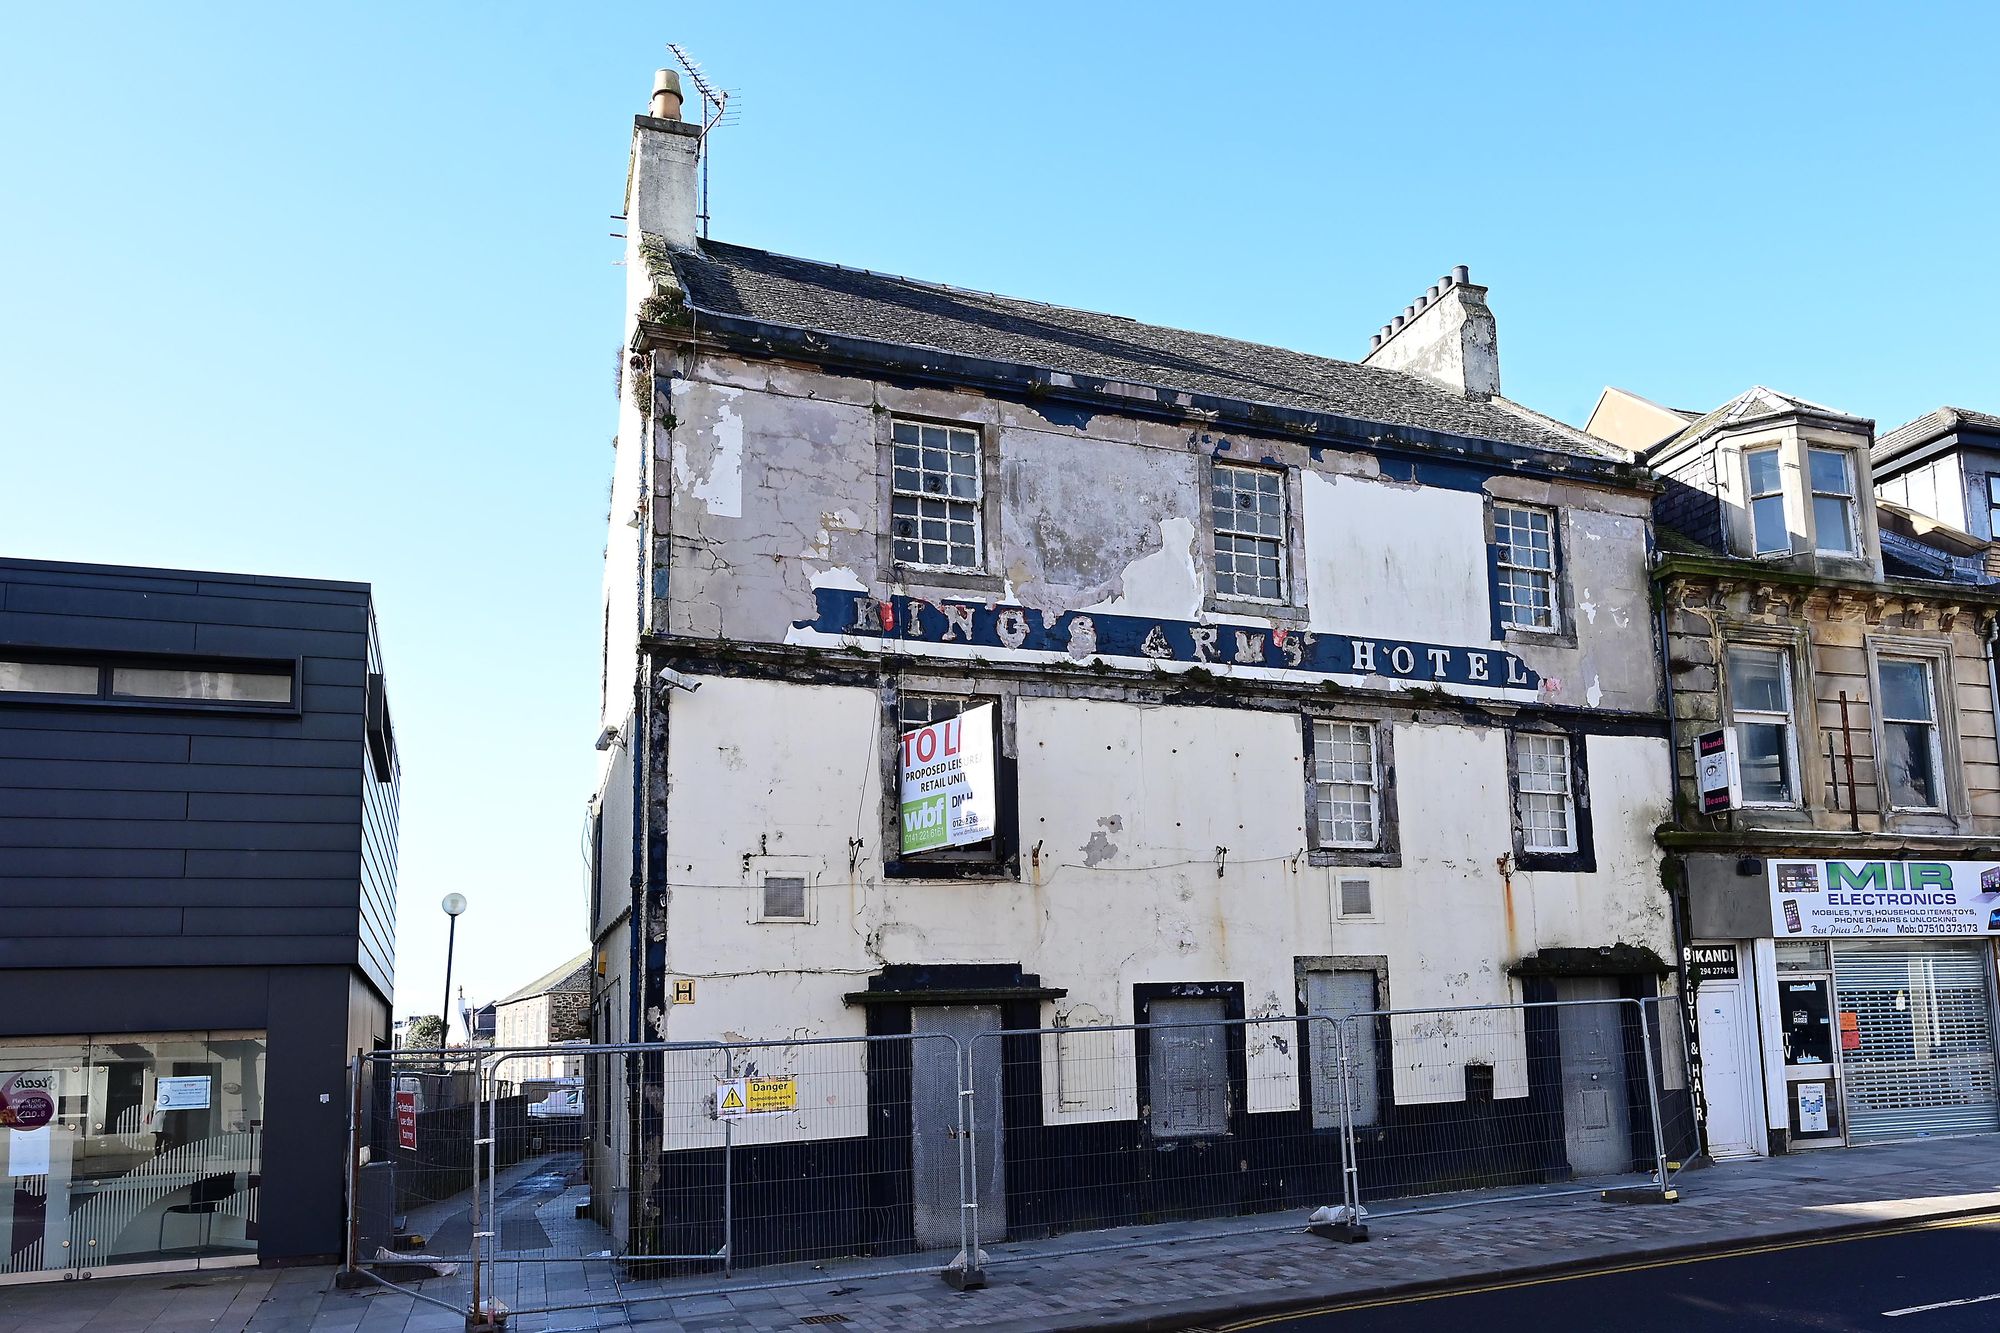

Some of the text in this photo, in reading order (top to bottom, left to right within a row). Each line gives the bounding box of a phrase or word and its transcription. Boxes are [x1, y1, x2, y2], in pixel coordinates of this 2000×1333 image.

[1352, 640, 1528, 685] HOTEL
[903, 727, 936, 768] TO
[906, 762, 947, 783] PROPOSED
[920, 777, 946, 793] RETAIL
[1705, 795, 1728, 806] Beauty
[904, 797, 944, 832] wbf
[1826, 861, 1954, 891] MIR
[1828, 893, 1957, 906] ELECTRONICS
[1811, 909, 1852, 917] MOBILES,
[1853, 909, 1875, 917] TV'S,
[1811, 923, 1978, 936] Best Prices In Irvine Mob: 07510 373173
[676, 982, 692, 1001] H
[1690, 1041, 1699, 1055] &
[753, 1083, 788, 1092] Danger
[1692, 1063, 1704, 1121] HAIR
